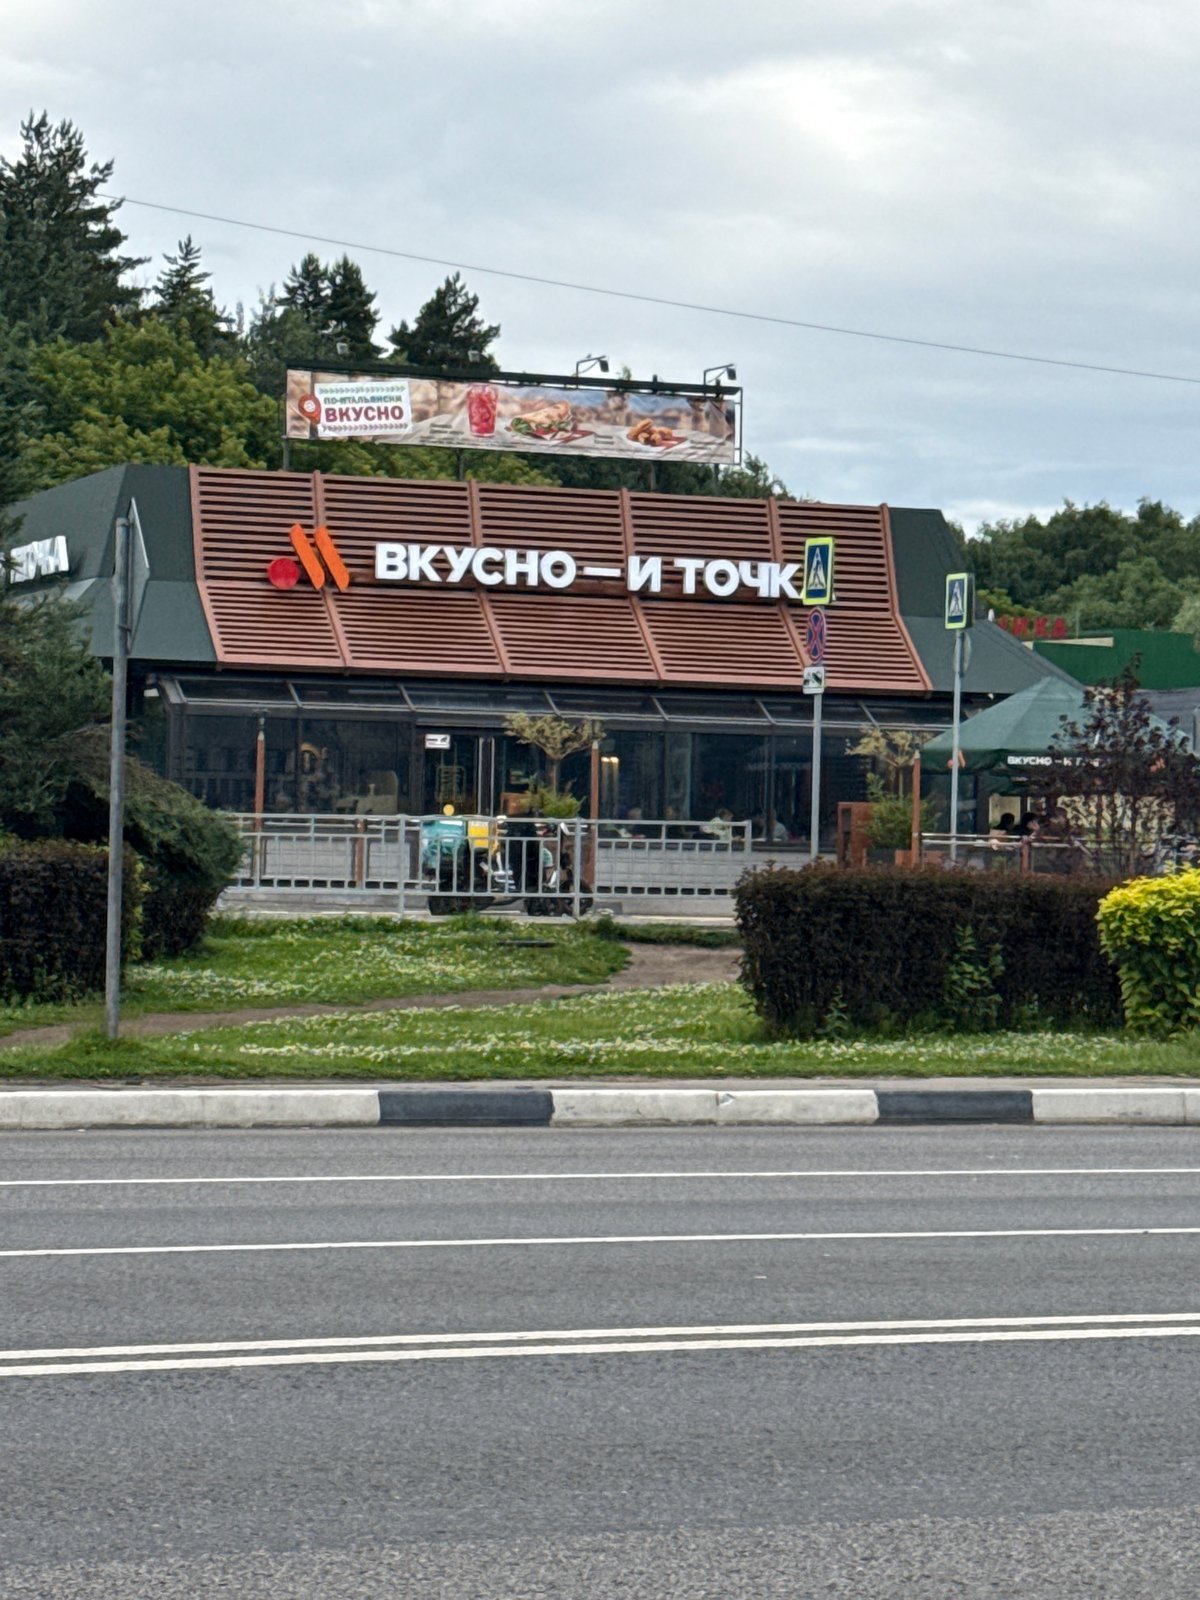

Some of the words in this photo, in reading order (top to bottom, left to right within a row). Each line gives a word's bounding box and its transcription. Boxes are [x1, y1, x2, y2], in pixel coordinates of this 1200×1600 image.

[325, 405, 404, 423] ВКУСНО
[375, 543, 577, 589] ВКУСНО
[627, 555, 662, 593] И
[674, 558, 836, 600] ТОЧК
[1007, 756, 1052, 766] ВКУСНО
